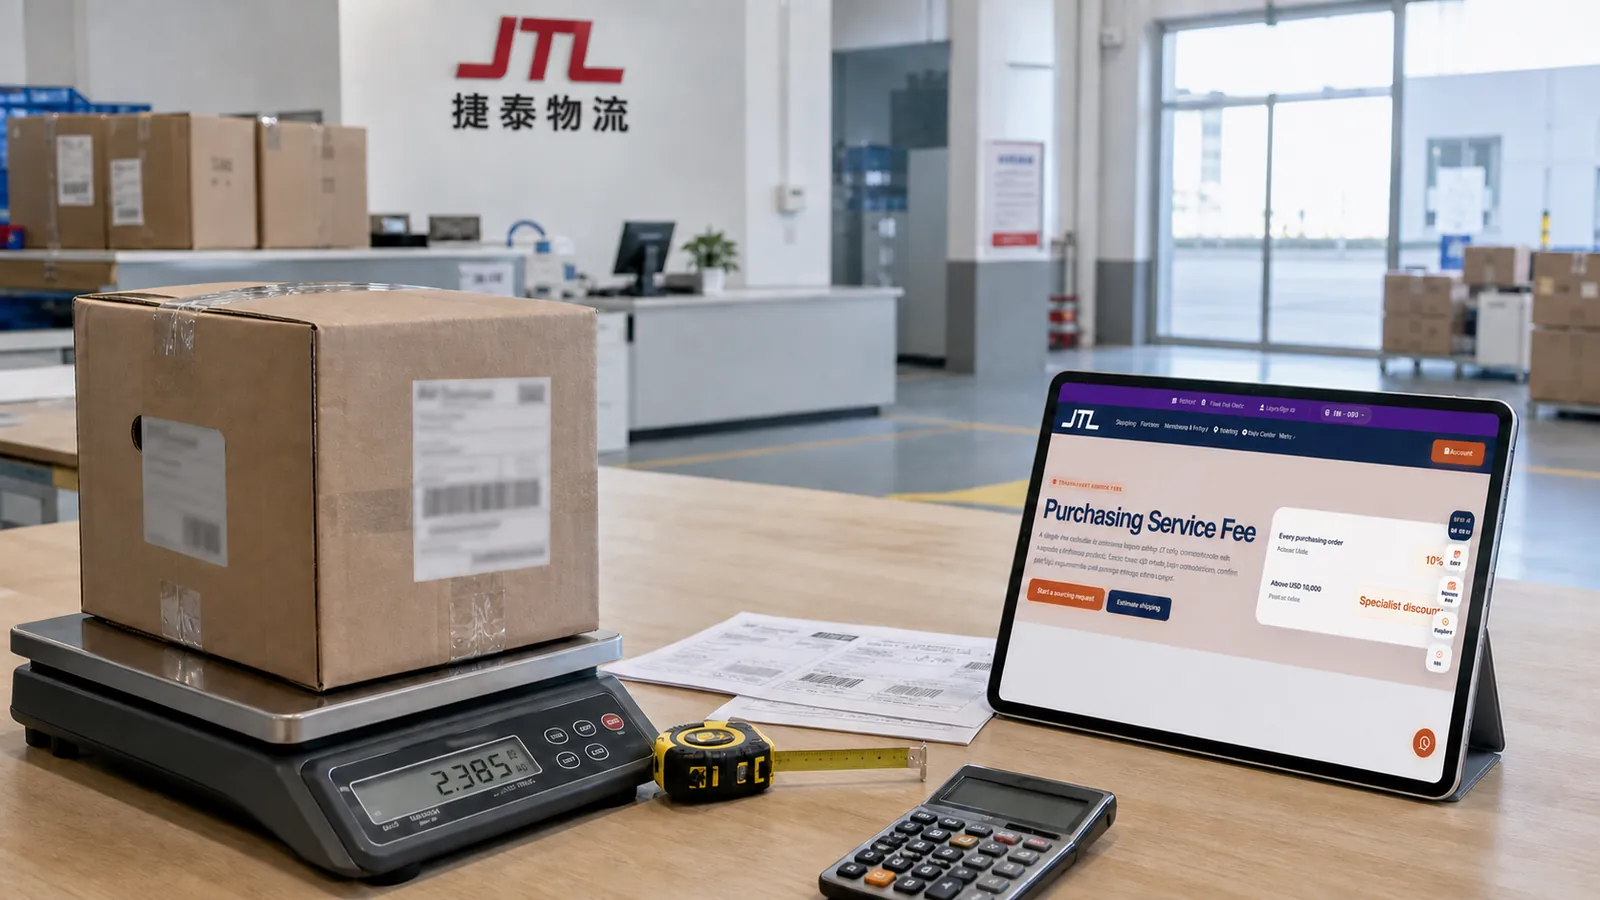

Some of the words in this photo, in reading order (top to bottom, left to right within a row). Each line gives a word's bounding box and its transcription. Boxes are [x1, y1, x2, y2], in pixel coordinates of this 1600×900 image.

[455, 15, 625, 84] JTL
[452, 92, 629, 133] 捷泰物流
[1061, 409, 1100, 430] JTL
[1450, 449, 1473, 457] Account
[1043, 498, 1144, 535] Purchasing
[1147, 510, 1217, 538] Service
[1220, 518, 1257, 543] Fee
[1279, 533, 1295, 541] Every
[1295, 535, 1327, 545] purchasing
[1425, 555, 1444, 566] 10%
[1037, 587, 1050, 595] Start
[1054, 591, 1075, 600] sourcing
[1076, 594, 1095, 602] request
[1270, 580, 1288, 588] Above
[1289, 582, 1302, 590] USD
[1303, 584, 1322, 592] 10,000
[1116, 599, 1139, 608] Estimate
[1139, 603, 1161, 612] shipping
[1359, 595, 1401, 611] Specialist
[1403, 601, 1444, 615] discoun
[430, 753, 513, 796] 2.385
